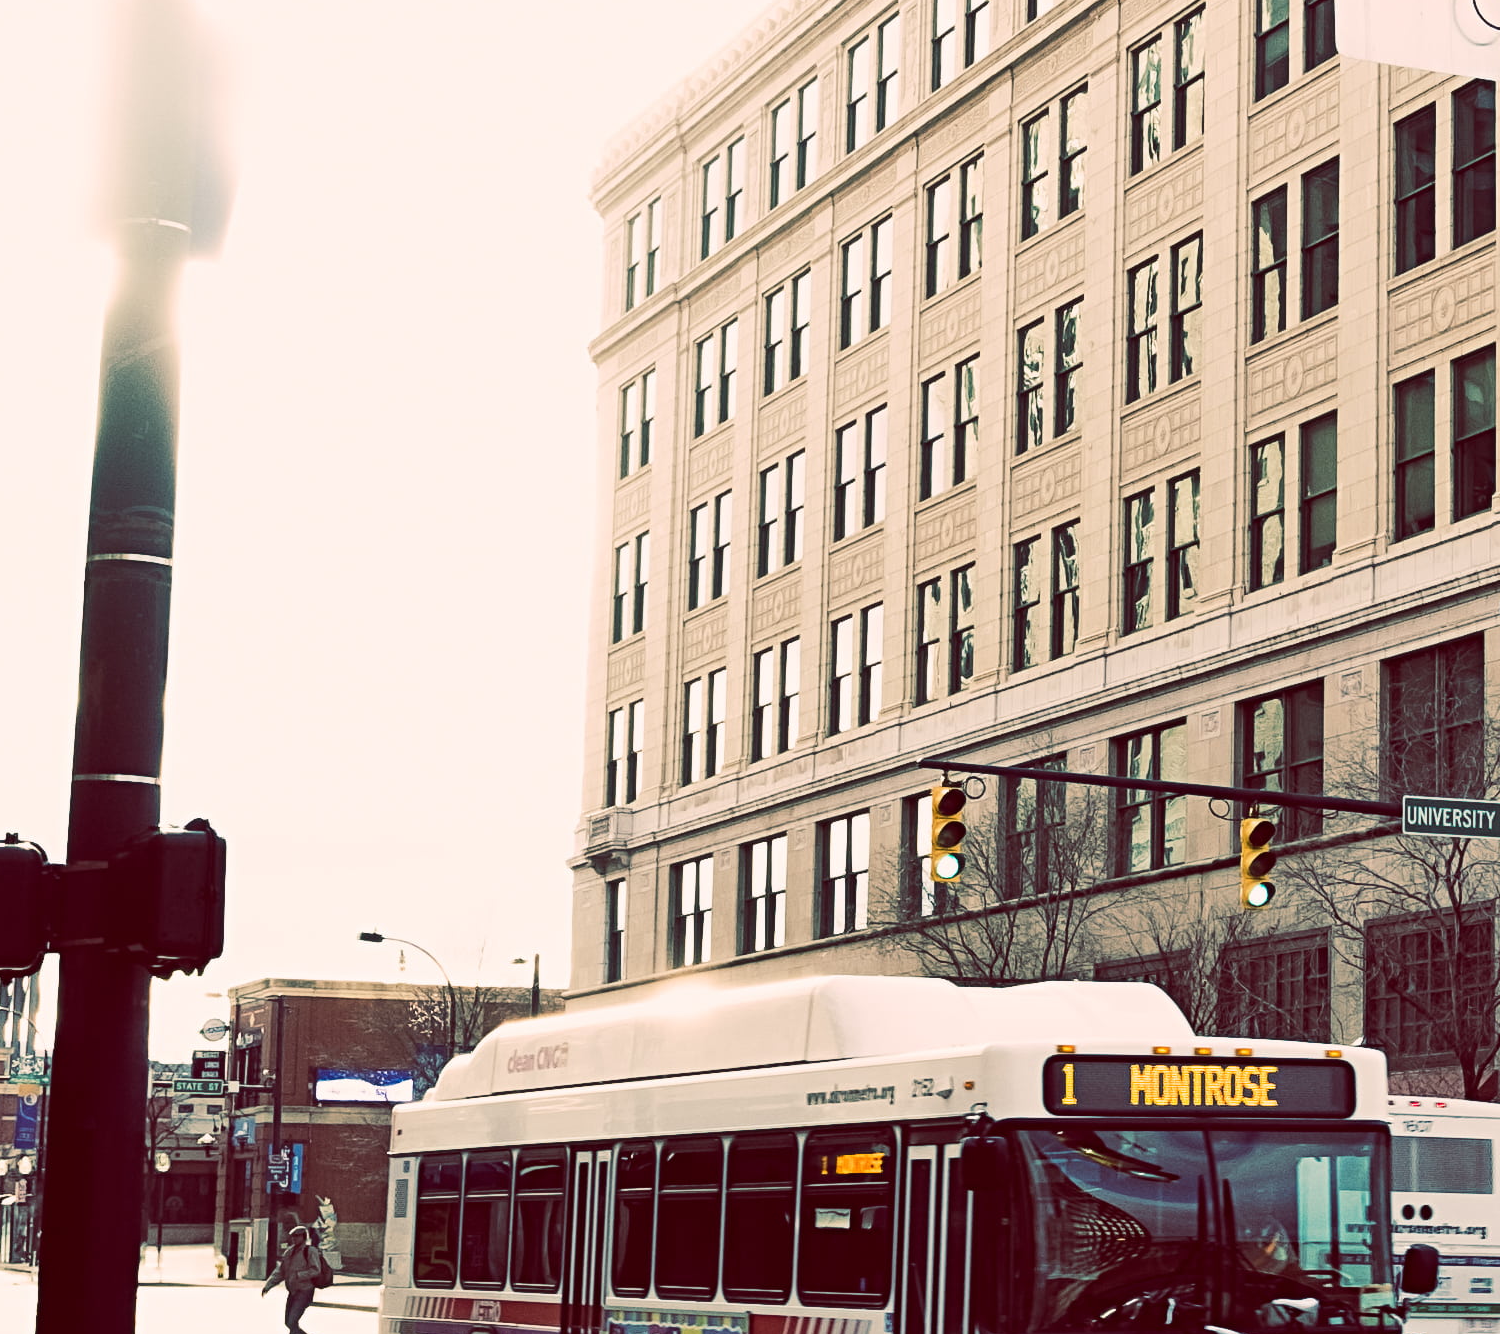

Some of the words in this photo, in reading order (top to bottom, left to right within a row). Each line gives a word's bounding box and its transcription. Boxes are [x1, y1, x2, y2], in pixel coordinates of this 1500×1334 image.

[1406, 806, 1496, 830] UNIVERSITY
[176, 1082, 204, 1091] STATE
[208, 1082, 219, 1091] ST
[1061, 1063, 1077, 1105] 1
[1129, 1064, 1279, 1107] MONTROSE
